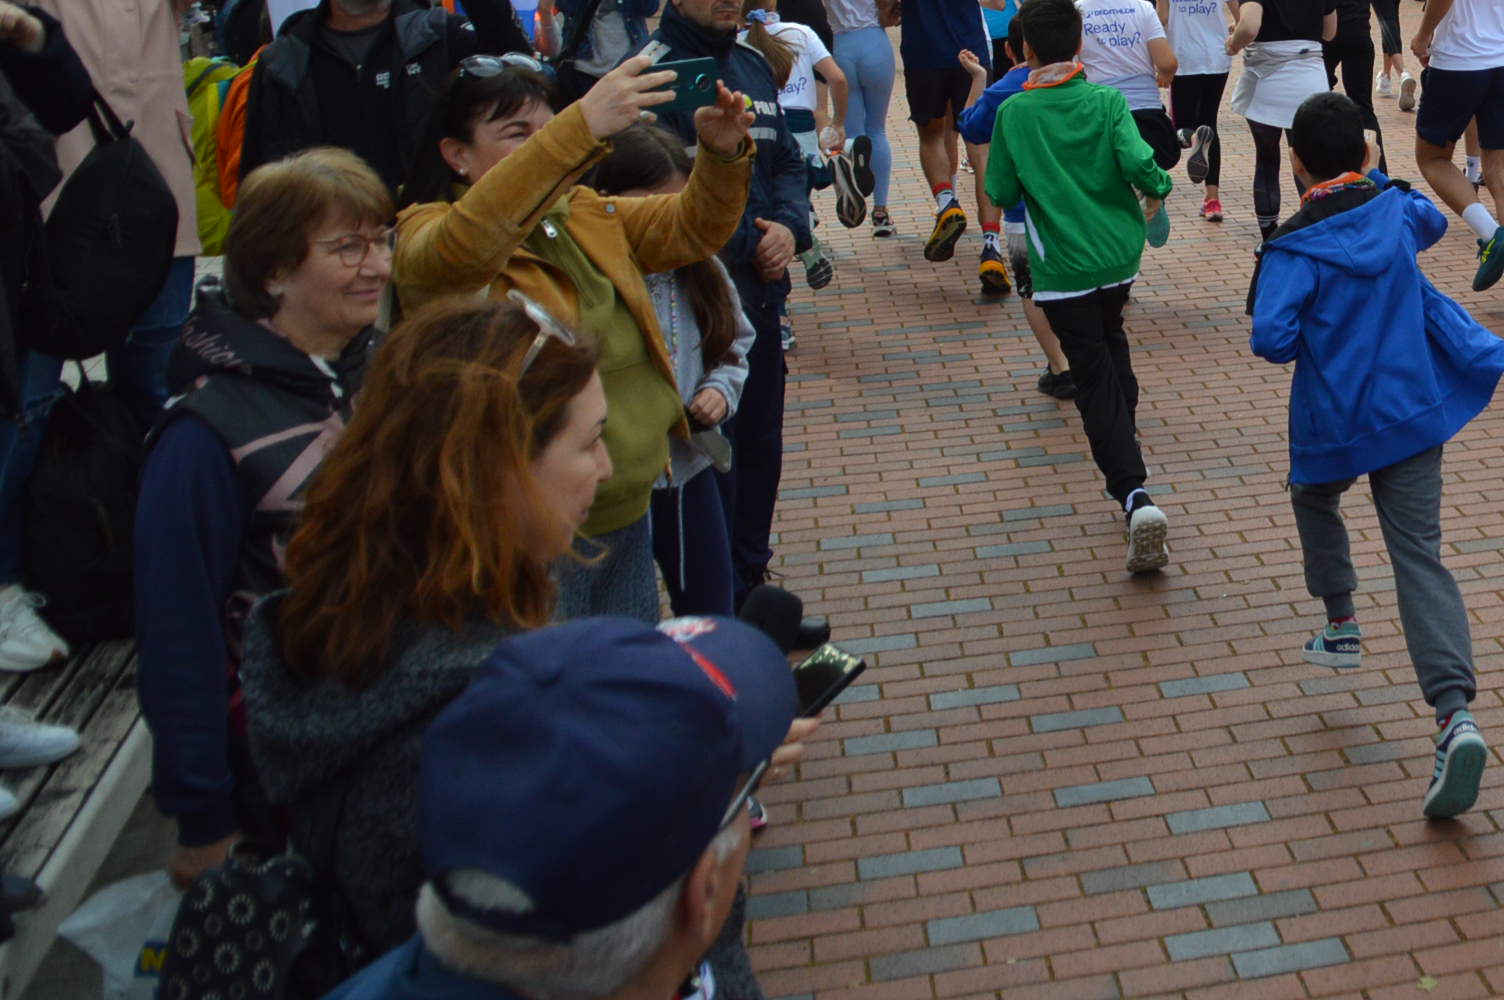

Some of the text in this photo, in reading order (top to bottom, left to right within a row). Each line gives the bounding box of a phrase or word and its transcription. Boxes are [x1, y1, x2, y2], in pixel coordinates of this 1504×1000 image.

[1188, 1, 1217, 17] play?
[1084, 20, 1126, 36] Ready
[1109, 31, 1141, 49] play?
